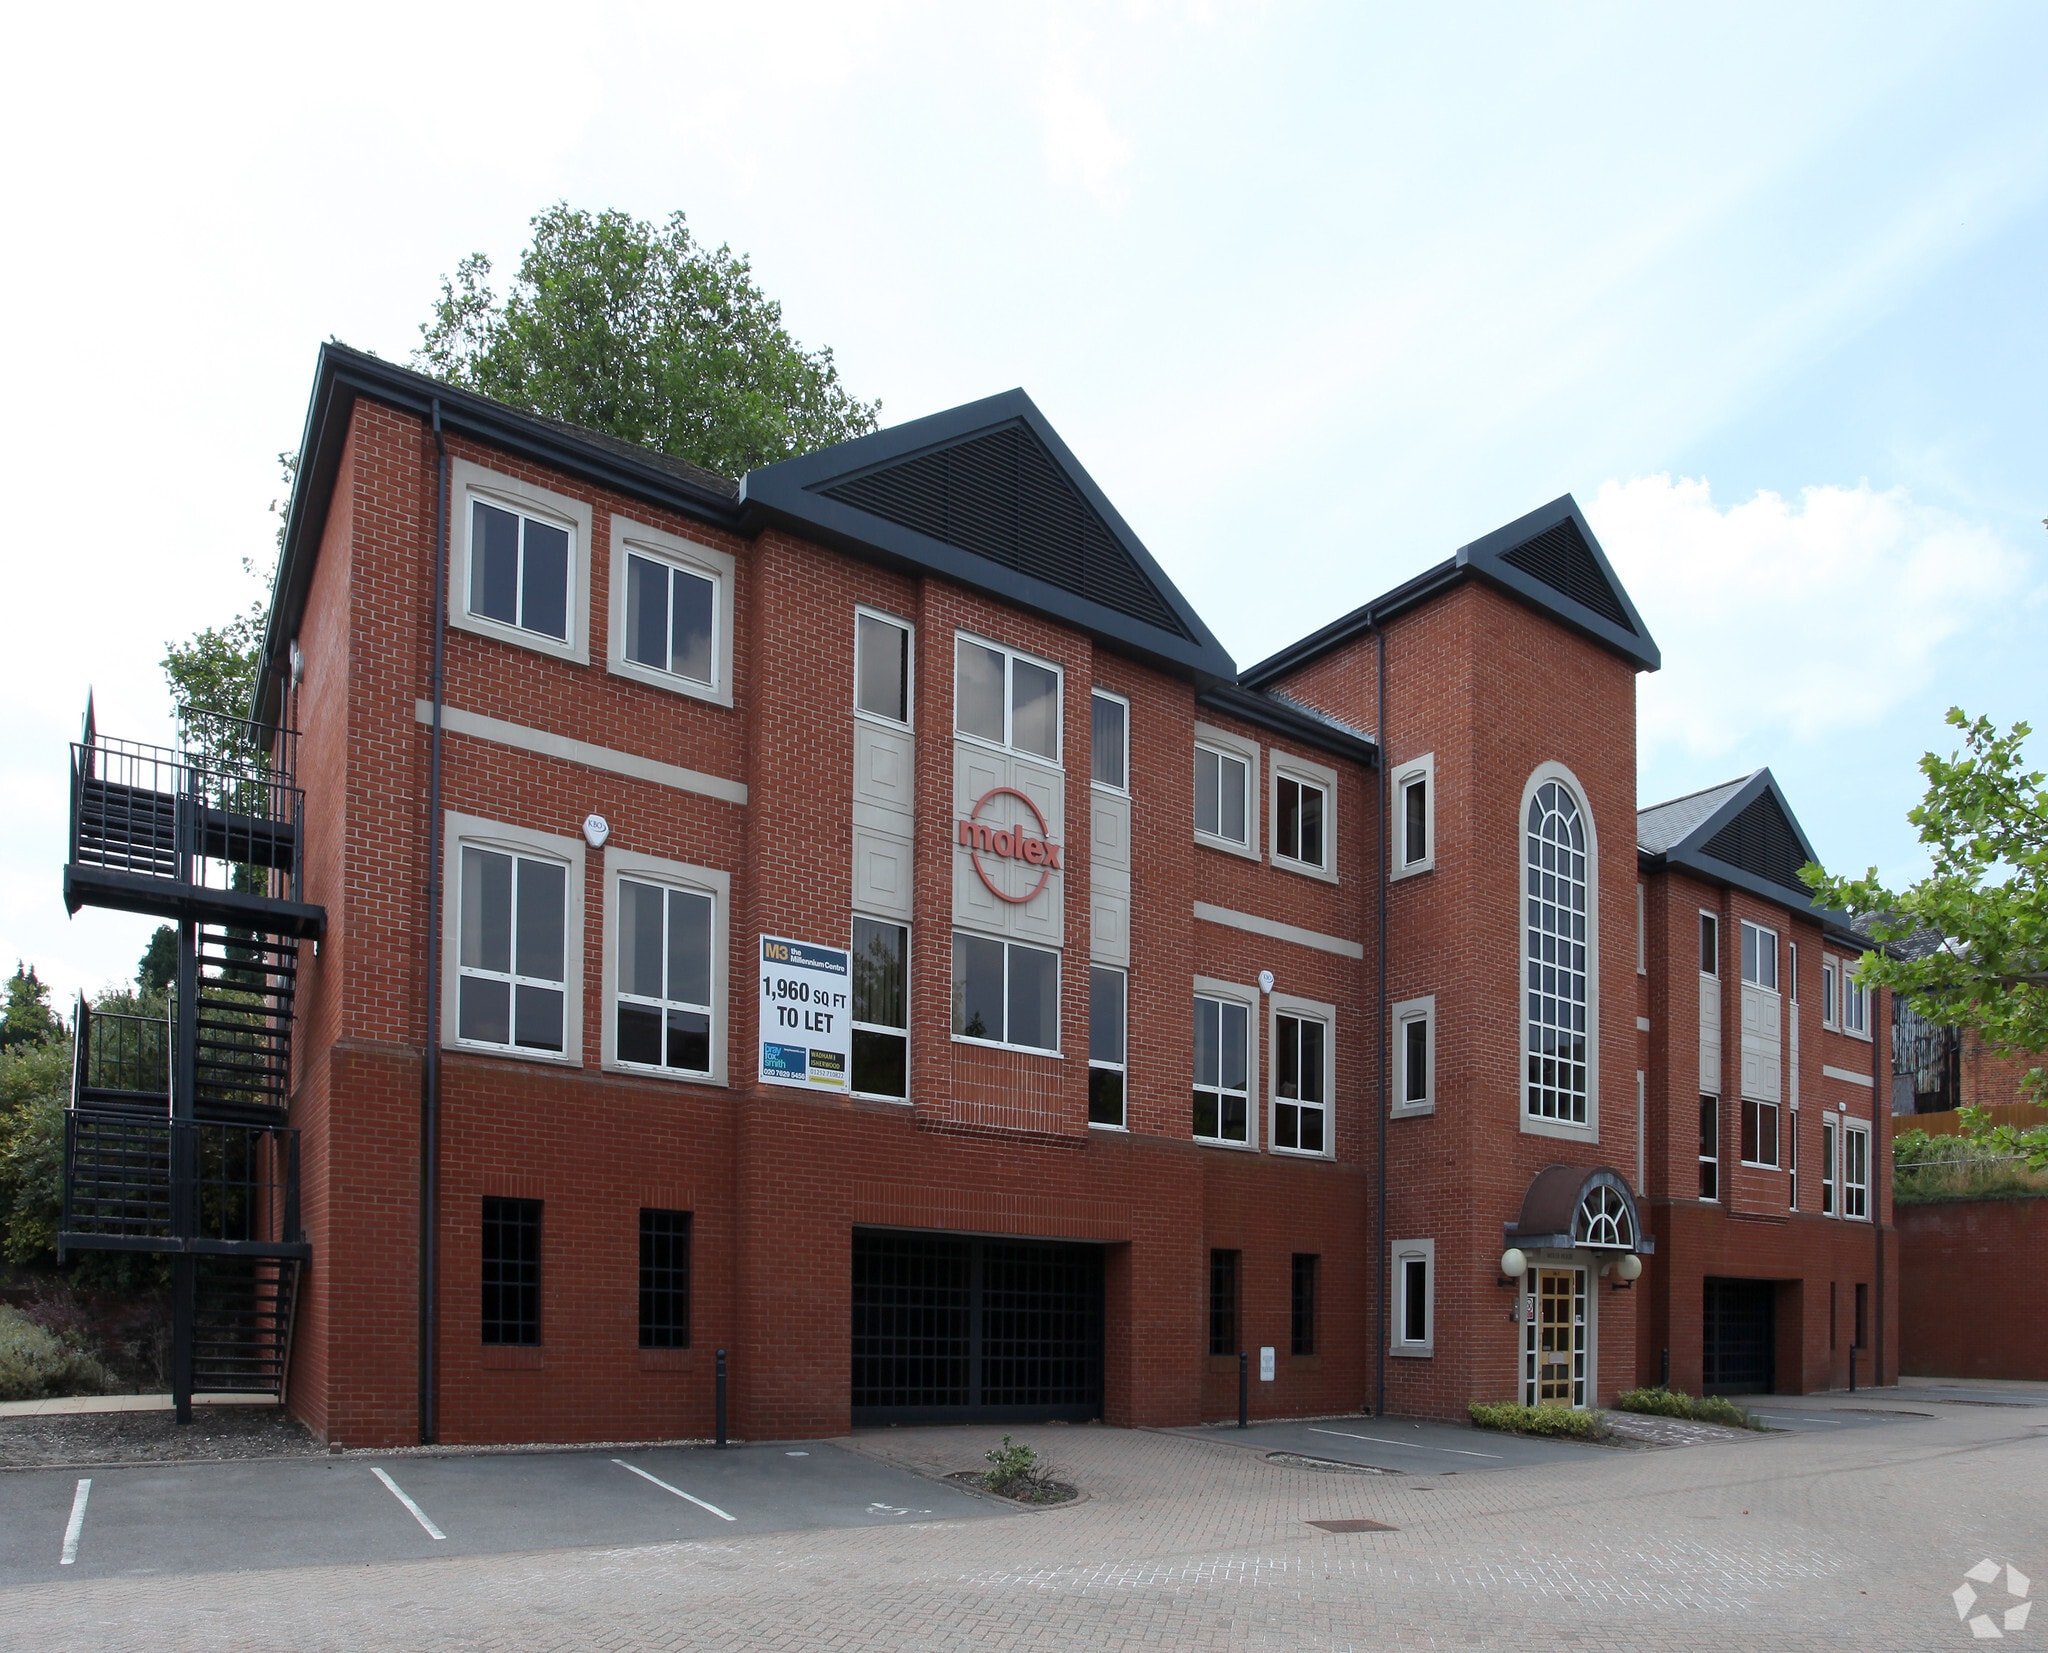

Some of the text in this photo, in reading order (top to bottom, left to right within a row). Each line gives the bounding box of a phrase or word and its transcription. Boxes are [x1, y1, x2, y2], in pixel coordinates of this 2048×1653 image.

[959, 820, 1060, 870] molex
[765, 943, 789, 960] M3
[790, 948, 802, 956] the
[790, 955, 845, 972] Millennium Centre
[763, 976, 847, 1008] 1,960 SQ FT
[777, 1006, 834, 1033] TO LET
[765, 1060, 786, 1069] smith
